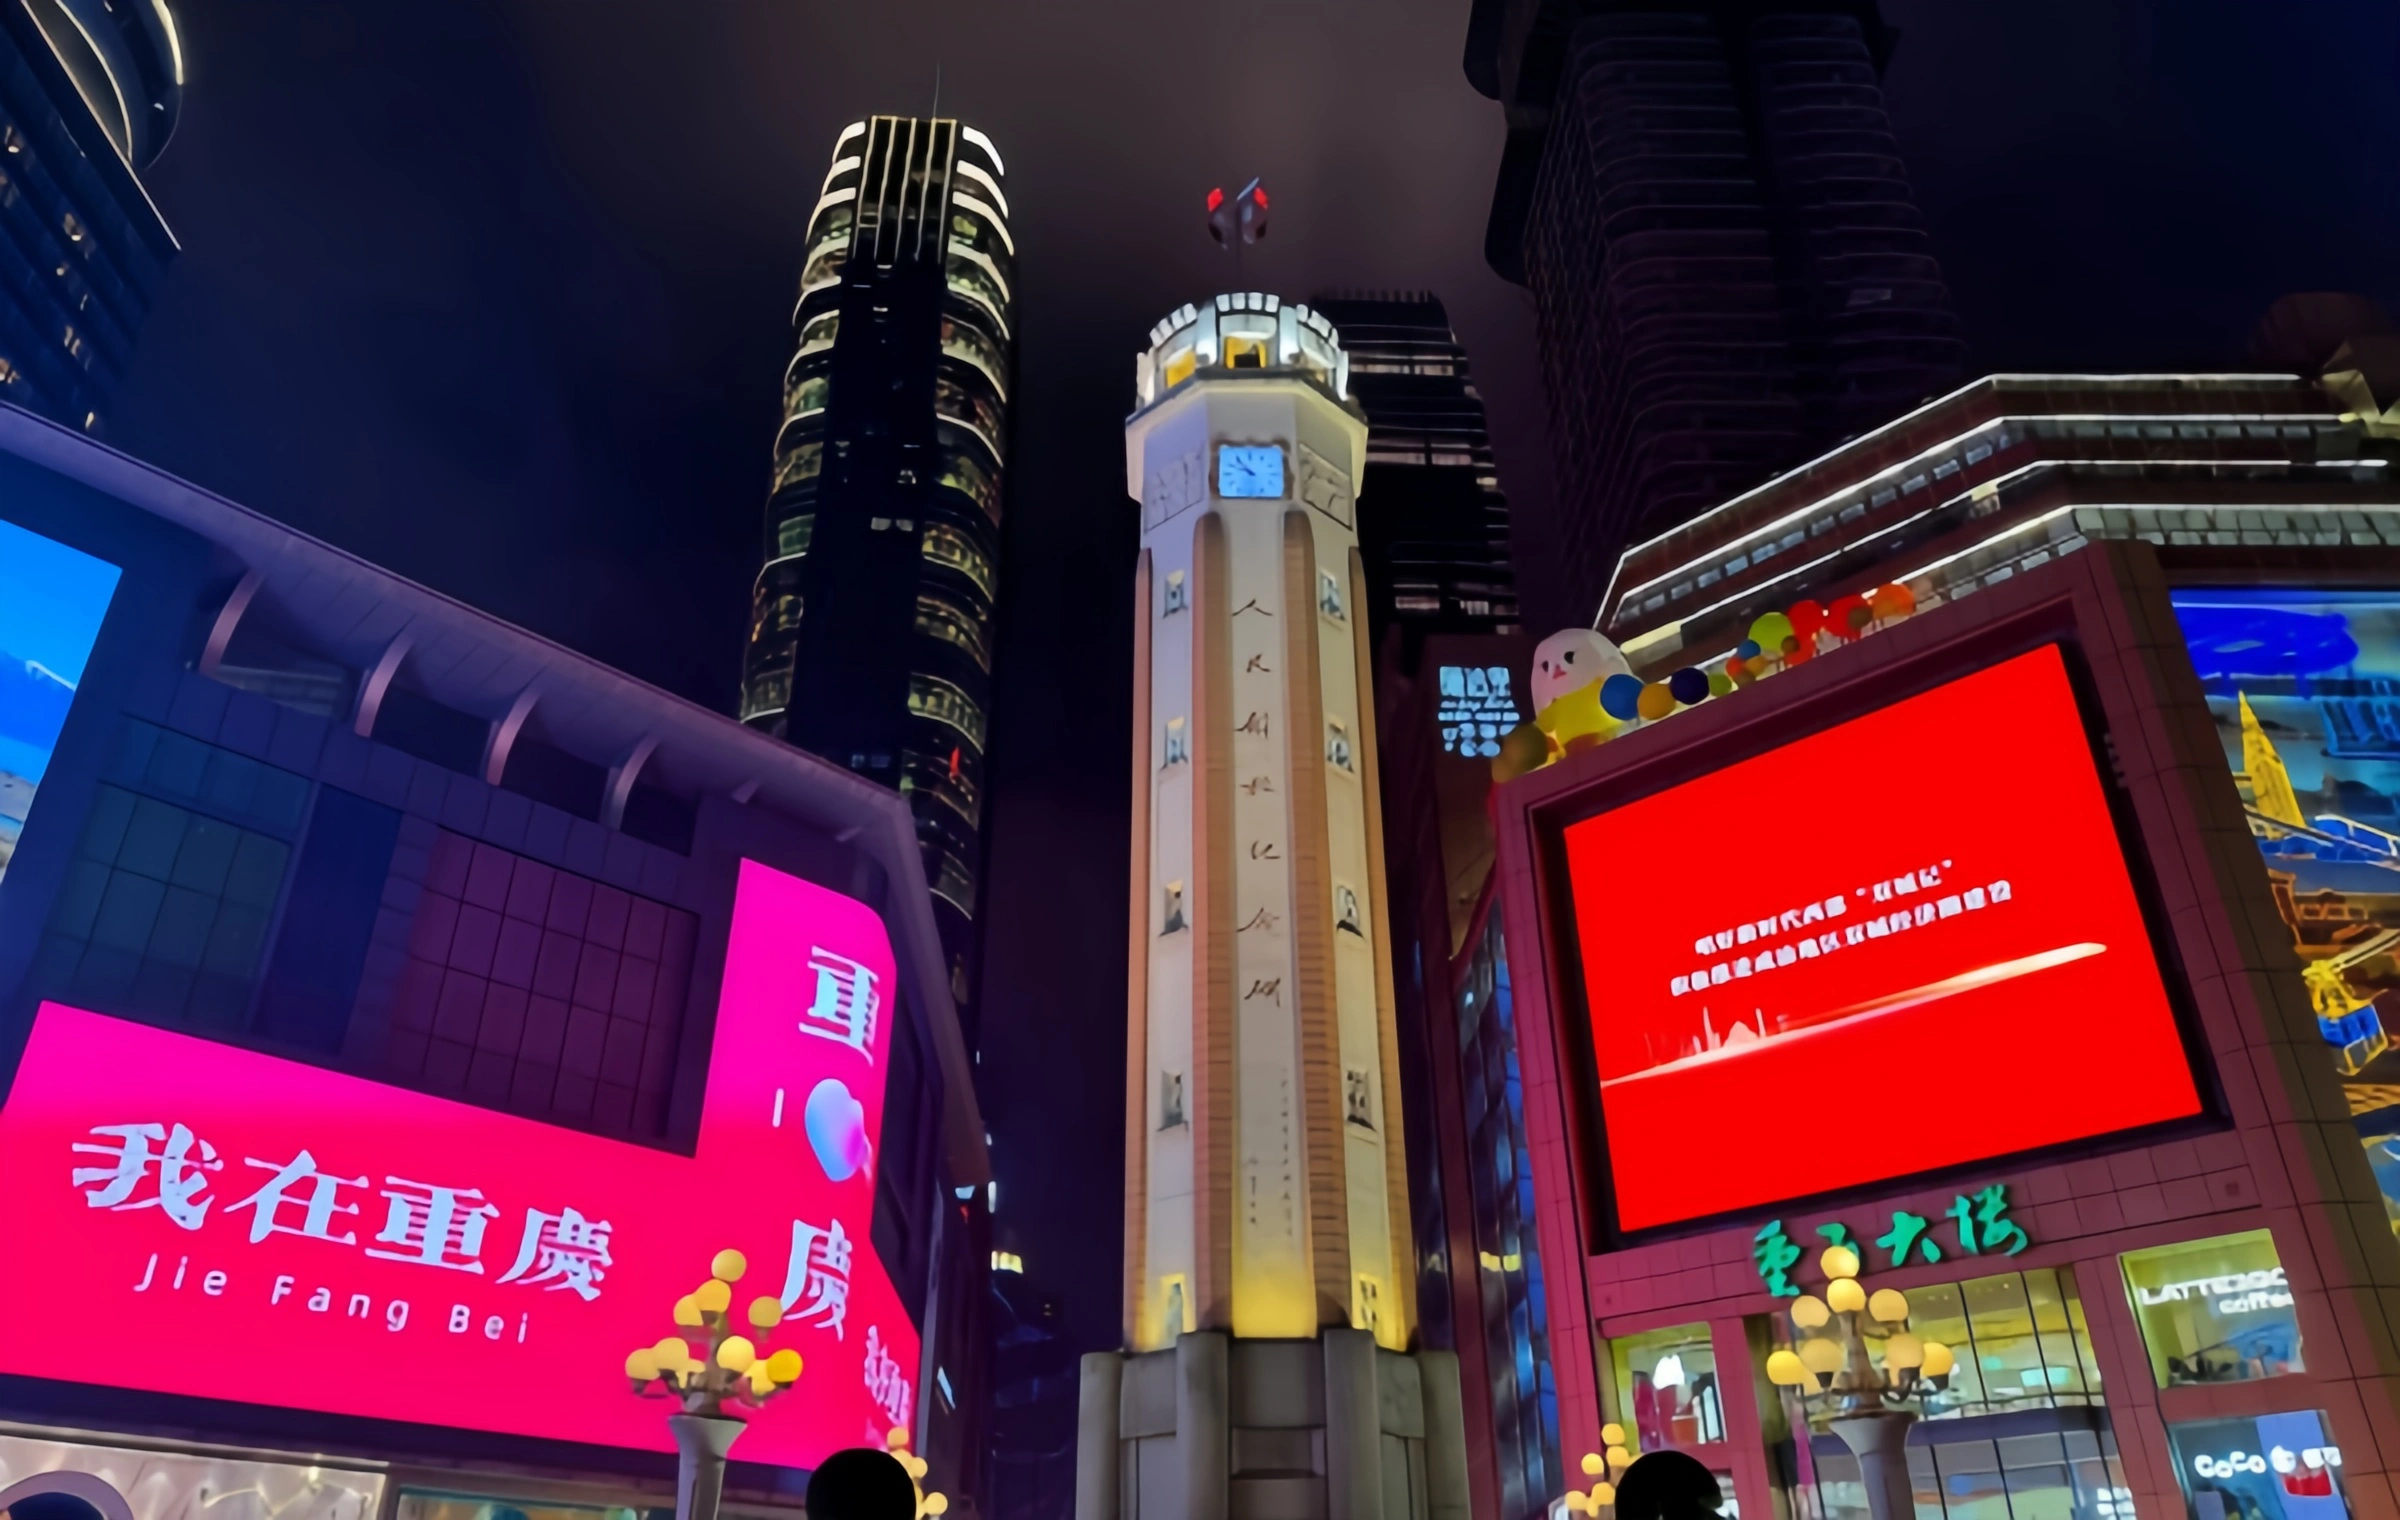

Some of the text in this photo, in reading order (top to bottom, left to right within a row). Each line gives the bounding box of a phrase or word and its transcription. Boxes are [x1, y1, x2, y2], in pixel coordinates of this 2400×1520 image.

[72, 1122, 613, 1301] 我在重慶
[134, 1253, 528, 1343] Jie Fang Bei
